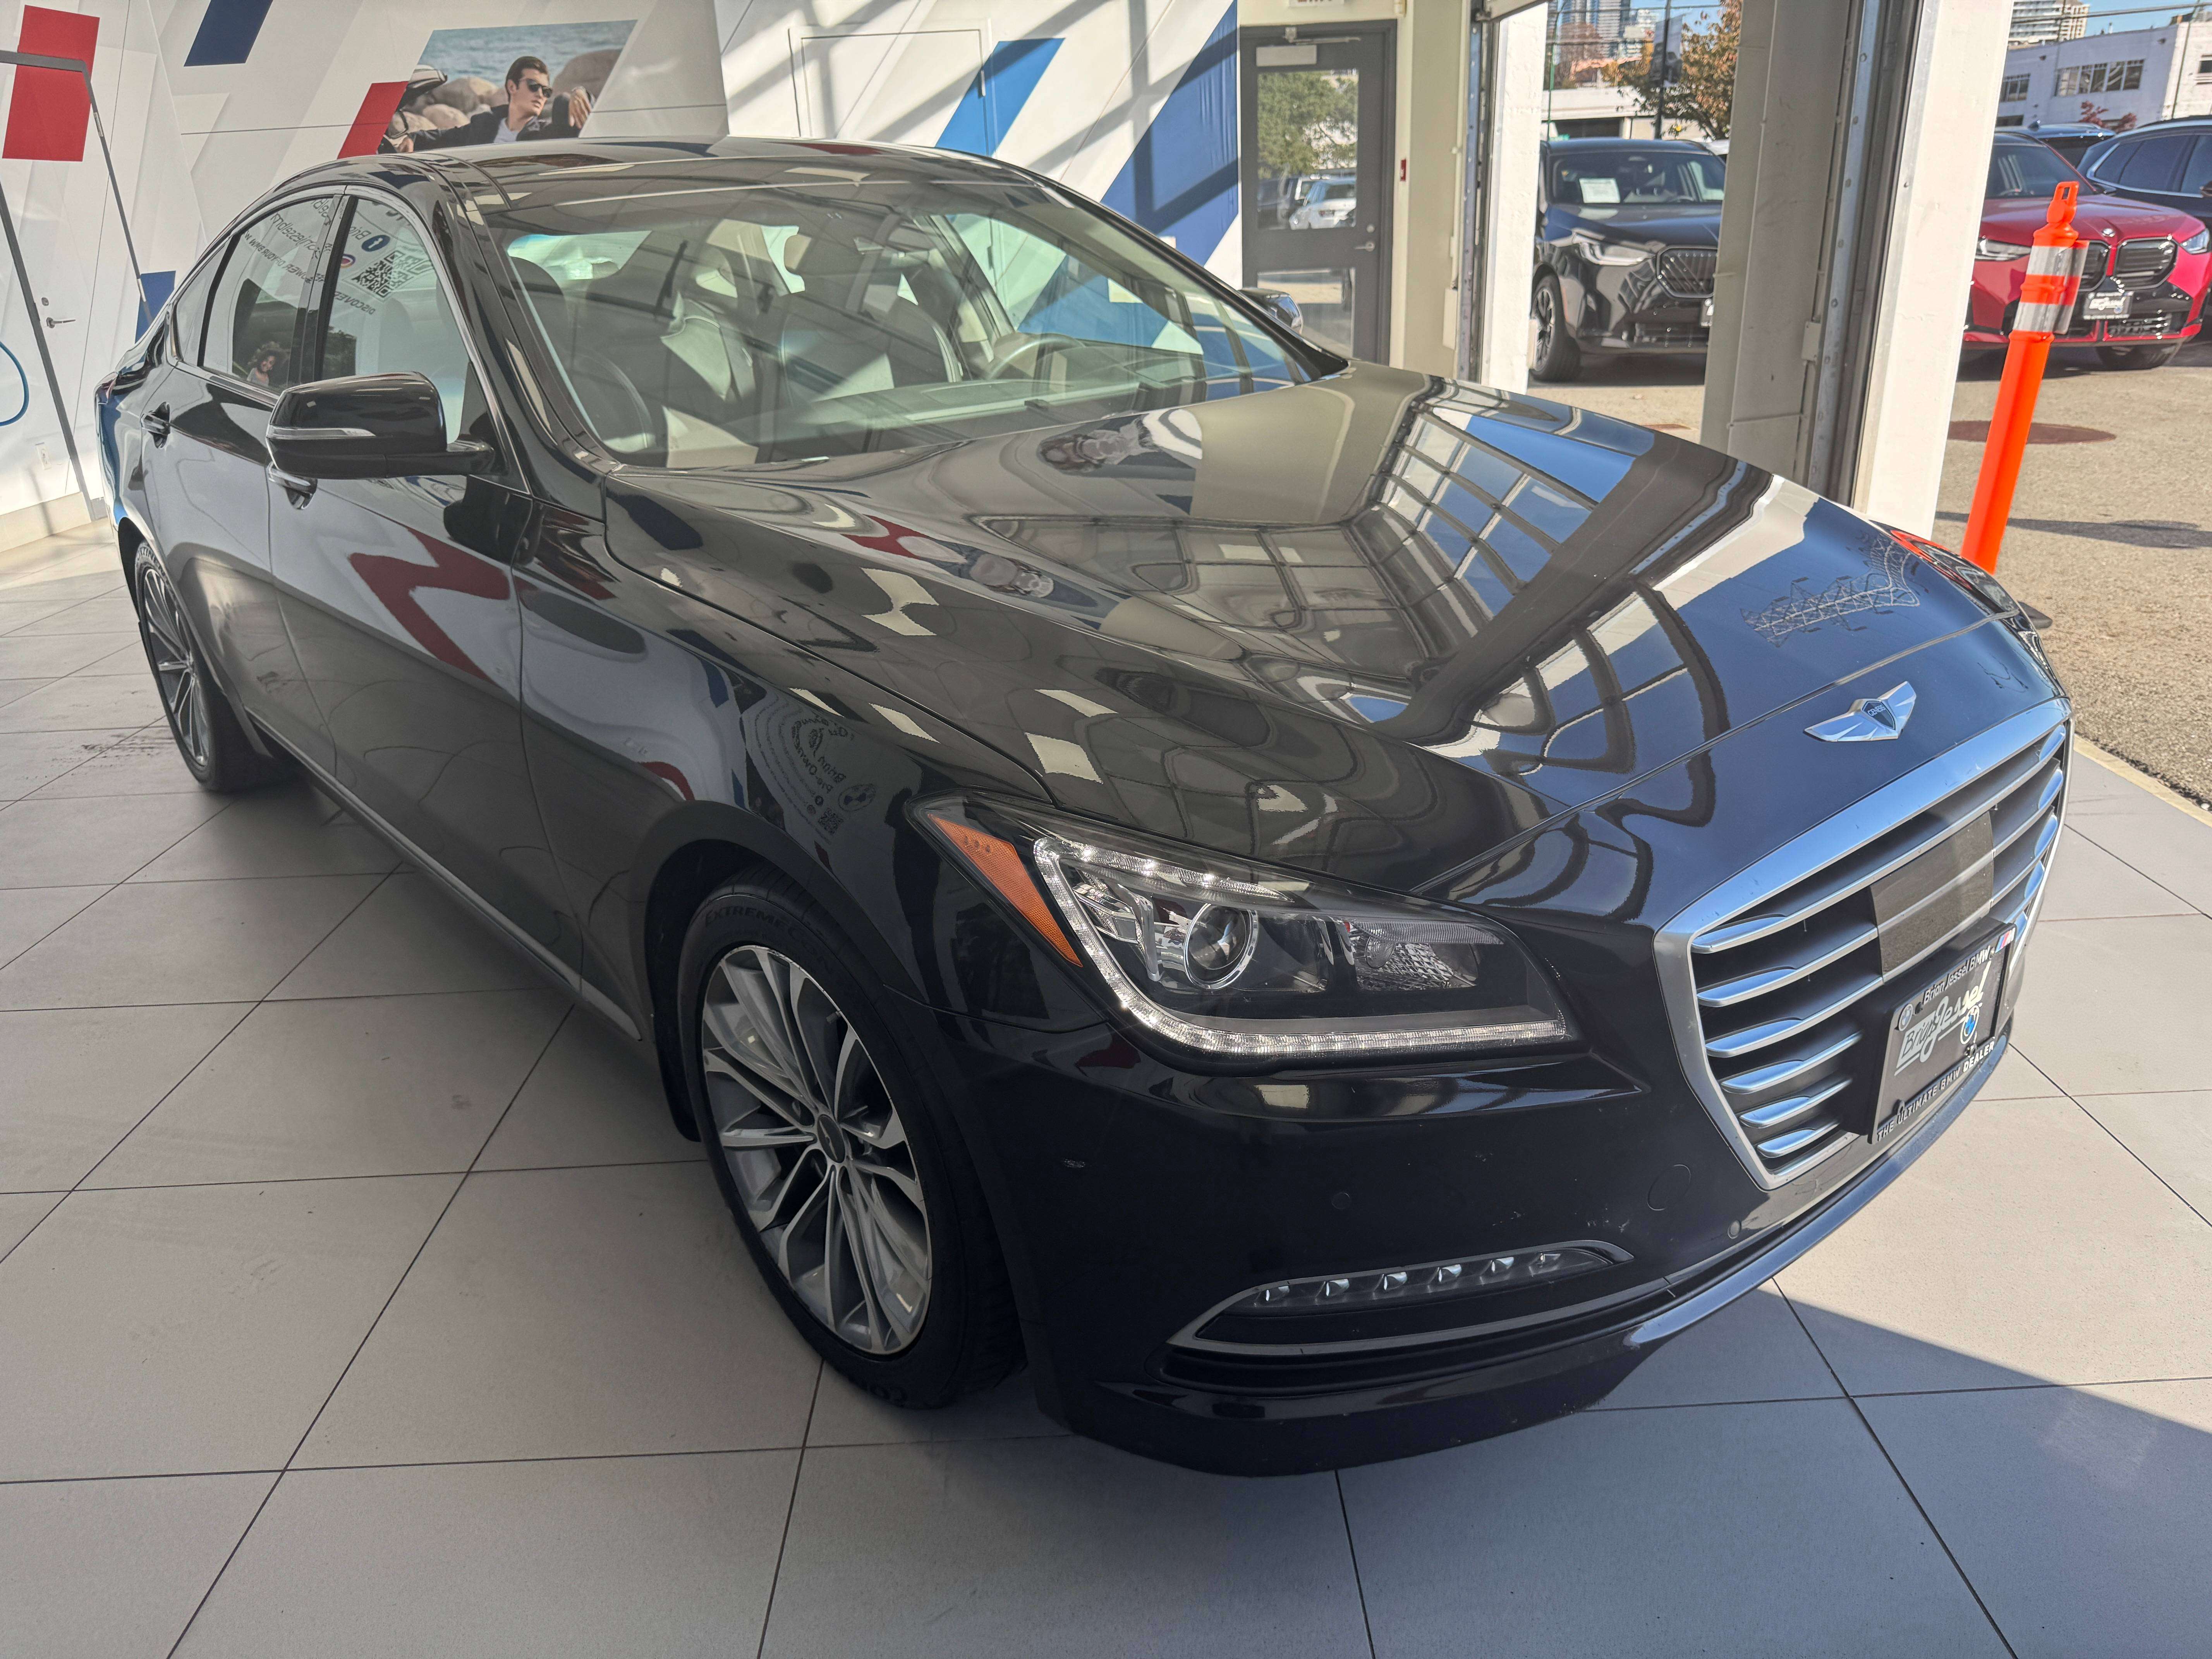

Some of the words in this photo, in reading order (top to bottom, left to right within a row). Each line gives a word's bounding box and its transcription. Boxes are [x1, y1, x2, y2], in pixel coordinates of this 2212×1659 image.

[1920, 960, 1992, 1063] Jessel
[1923, 981, 1945, 1005] Brian
[1944, 959, 1968, 990] Jessel
[1969, 945, 1991, 972] BMW
[1877, 1121, 1894, 1142] THE
[1897, 1085, 1938, 1125] ULTIMATE
[1940, 1067, 1961, 1091] BMW
[1963, 1041, 1995, 1073] DEALER
